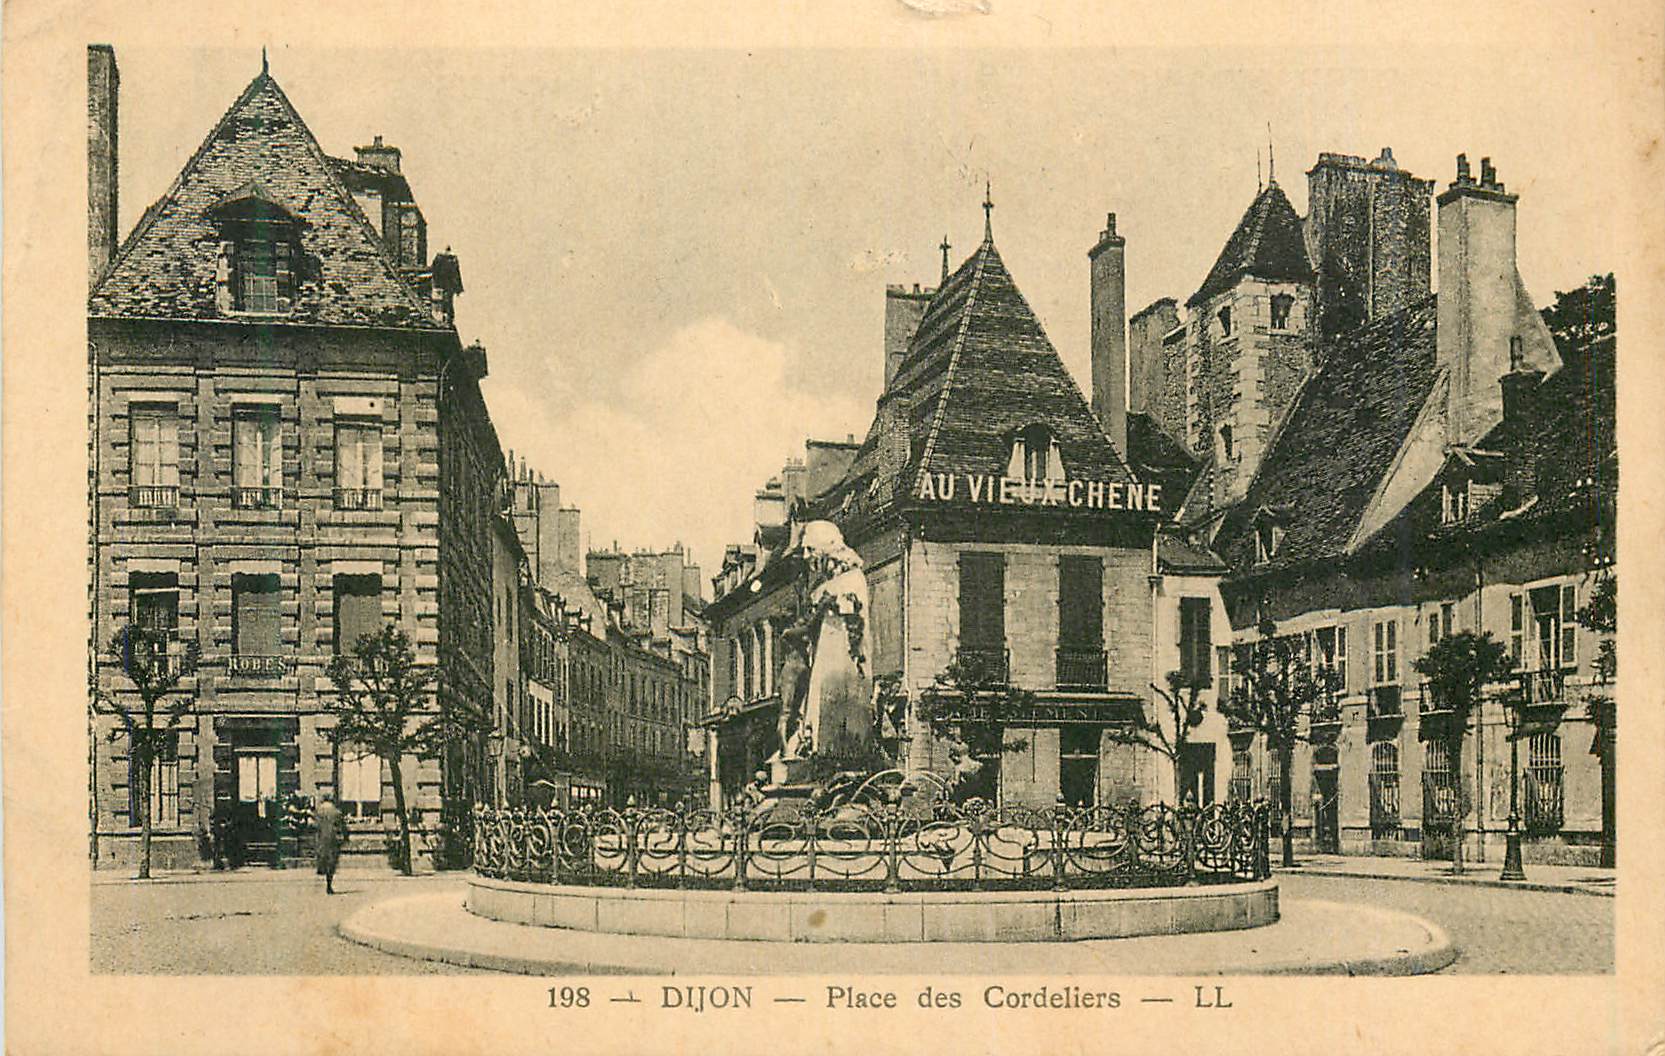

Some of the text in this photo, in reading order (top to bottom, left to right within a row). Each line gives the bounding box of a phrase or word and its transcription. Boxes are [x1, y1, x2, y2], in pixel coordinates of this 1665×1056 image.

[919, 472, 1162, 511] AU VIEUX CHENE
[228, 656, 287, 672] ROBES
